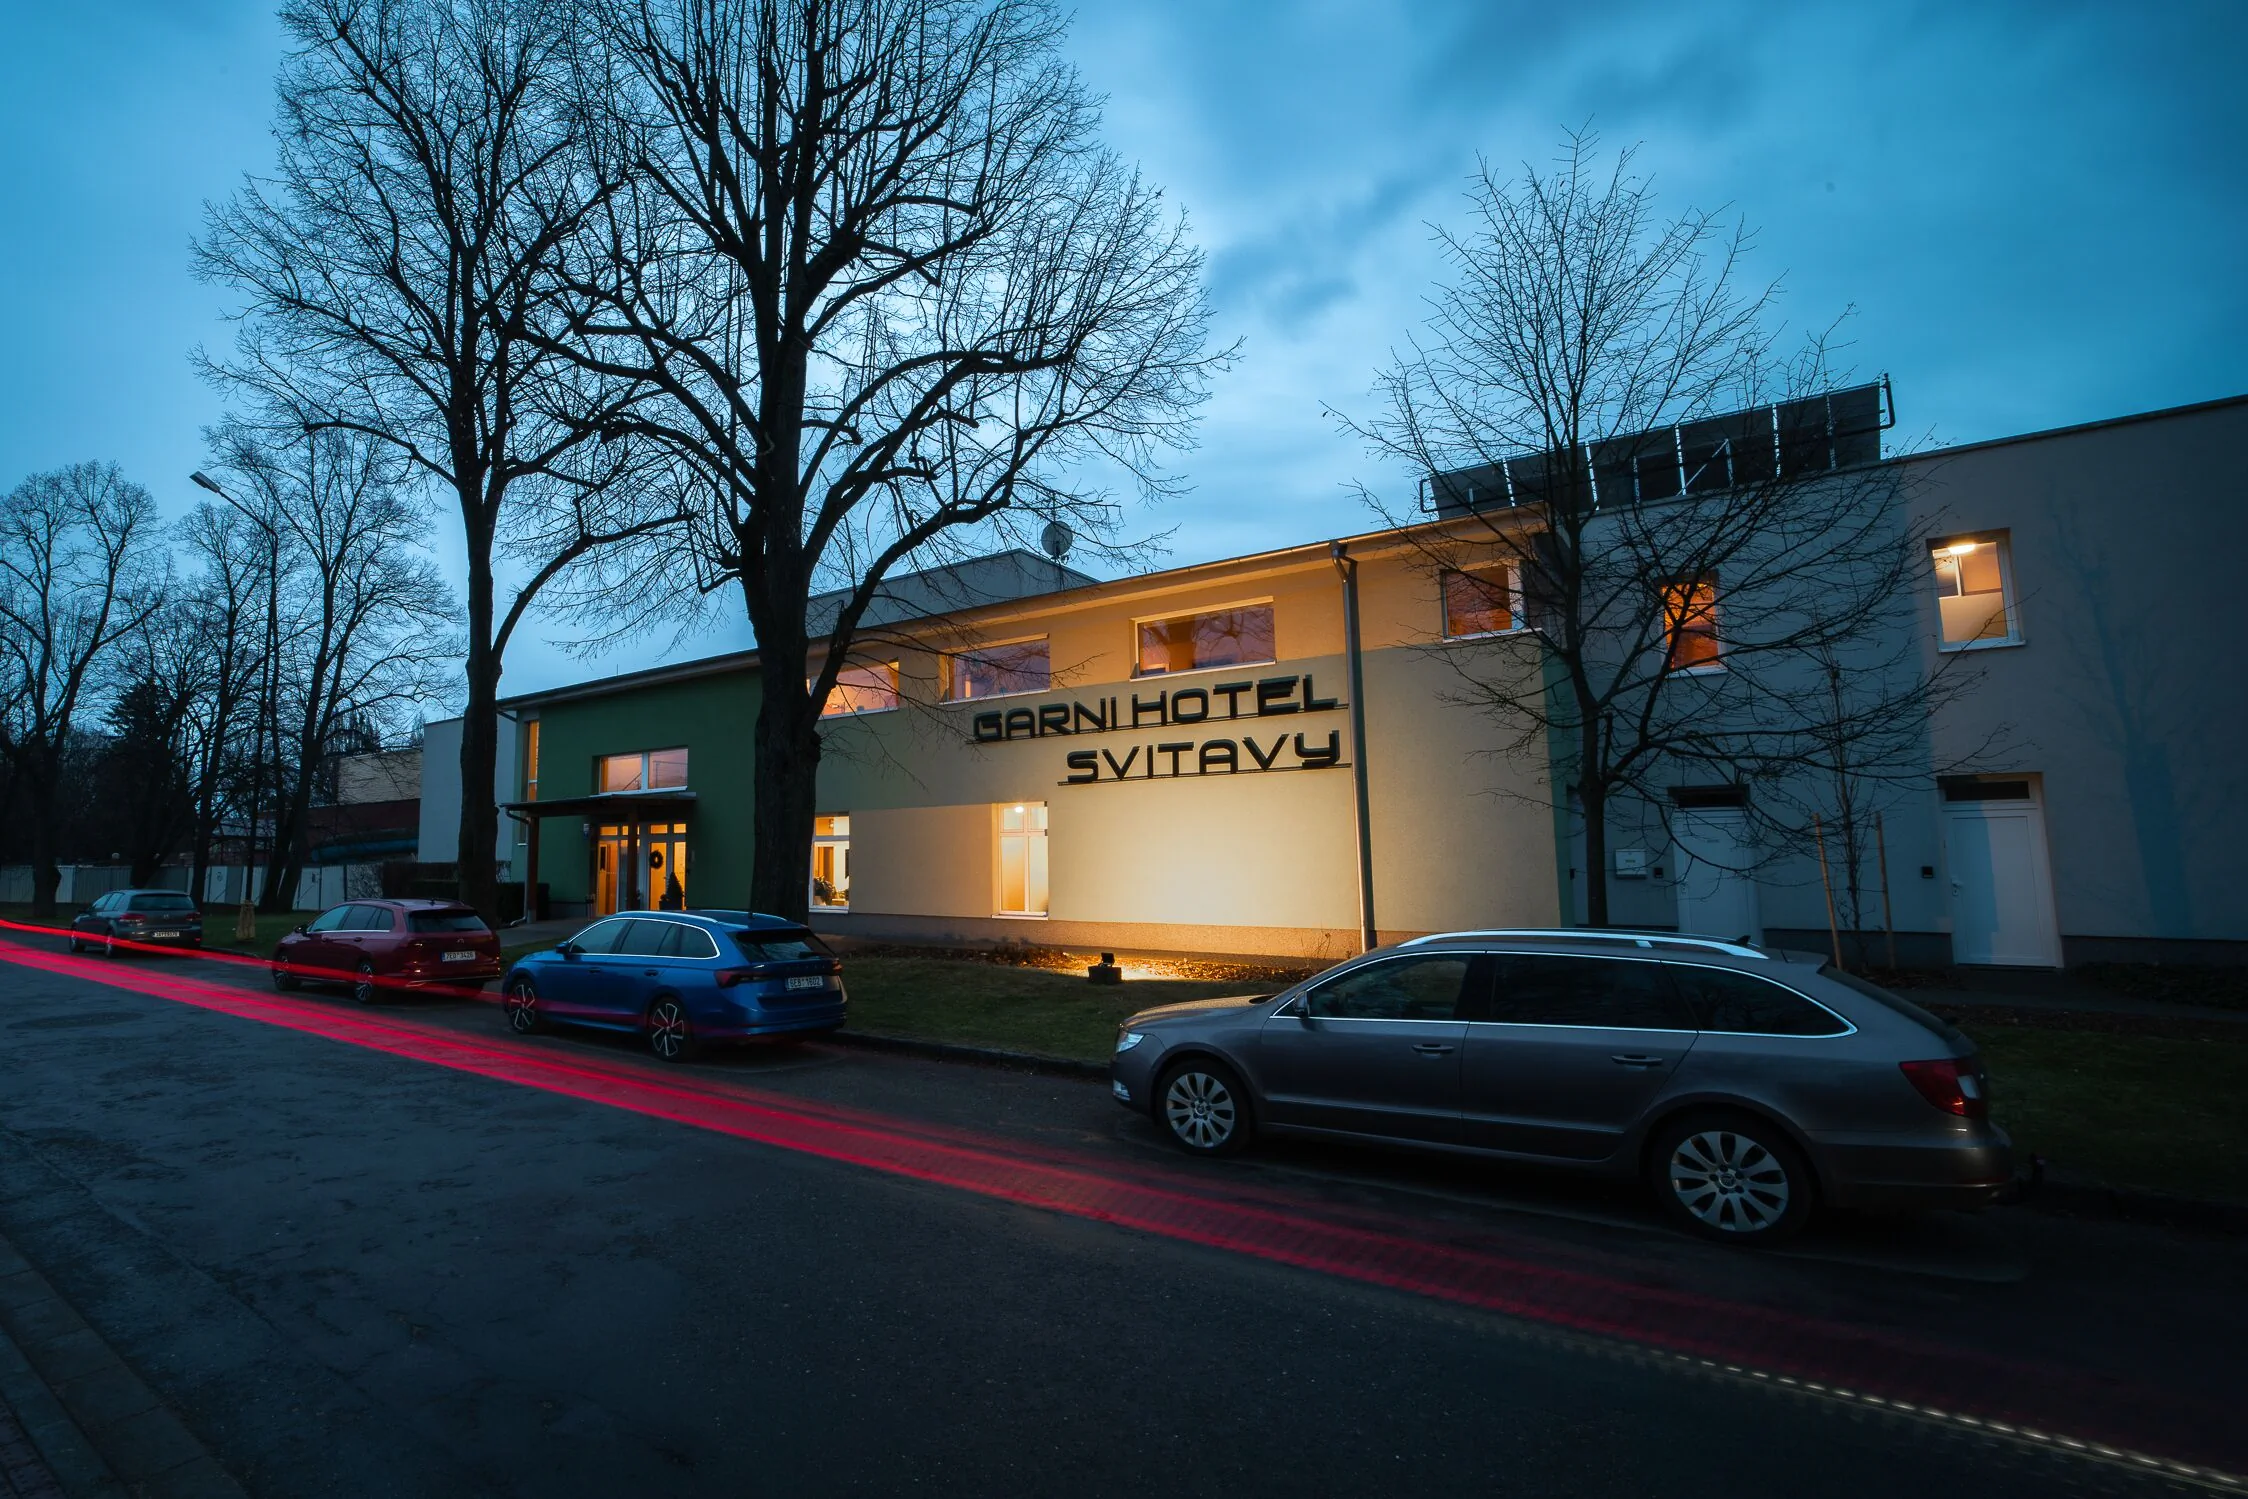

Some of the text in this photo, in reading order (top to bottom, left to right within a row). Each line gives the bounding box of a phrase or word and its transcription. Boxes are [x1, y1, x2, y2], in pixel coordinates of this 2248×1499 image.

[973, 674, 1339, 742] GARNI HOTEL
[1066, 730, 1340, 784] SVITAVY
